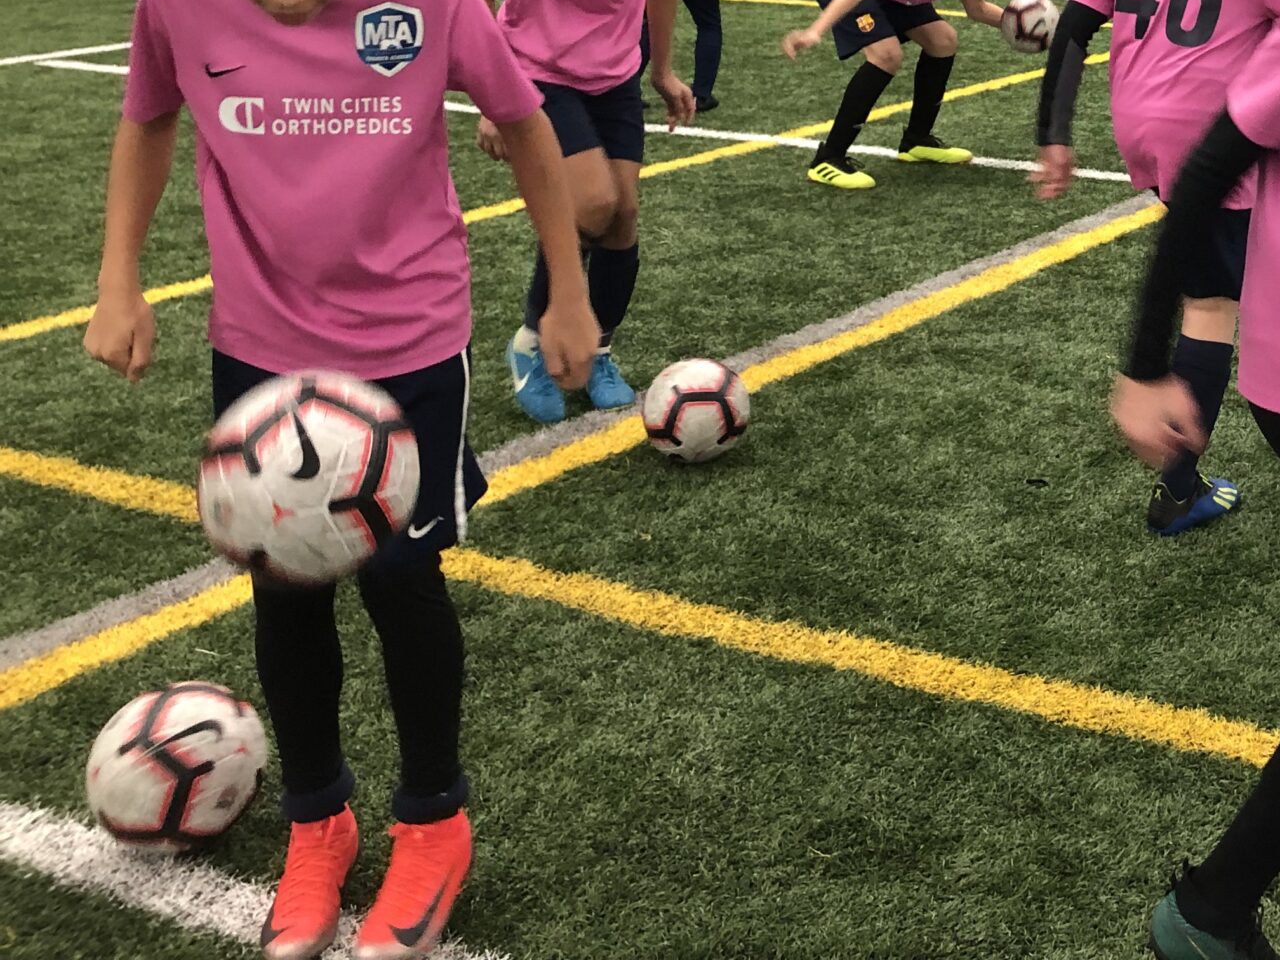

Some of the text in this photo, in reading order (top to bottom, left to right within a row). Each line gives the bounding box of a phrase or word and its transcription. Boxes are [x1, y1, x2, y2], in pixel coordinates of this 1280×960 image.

[364, 15, 414, 46] MTA
[282, 96, 402, 115] TWIN CITIES
[272, 117, 413, 136] ORTHOPEDICS
